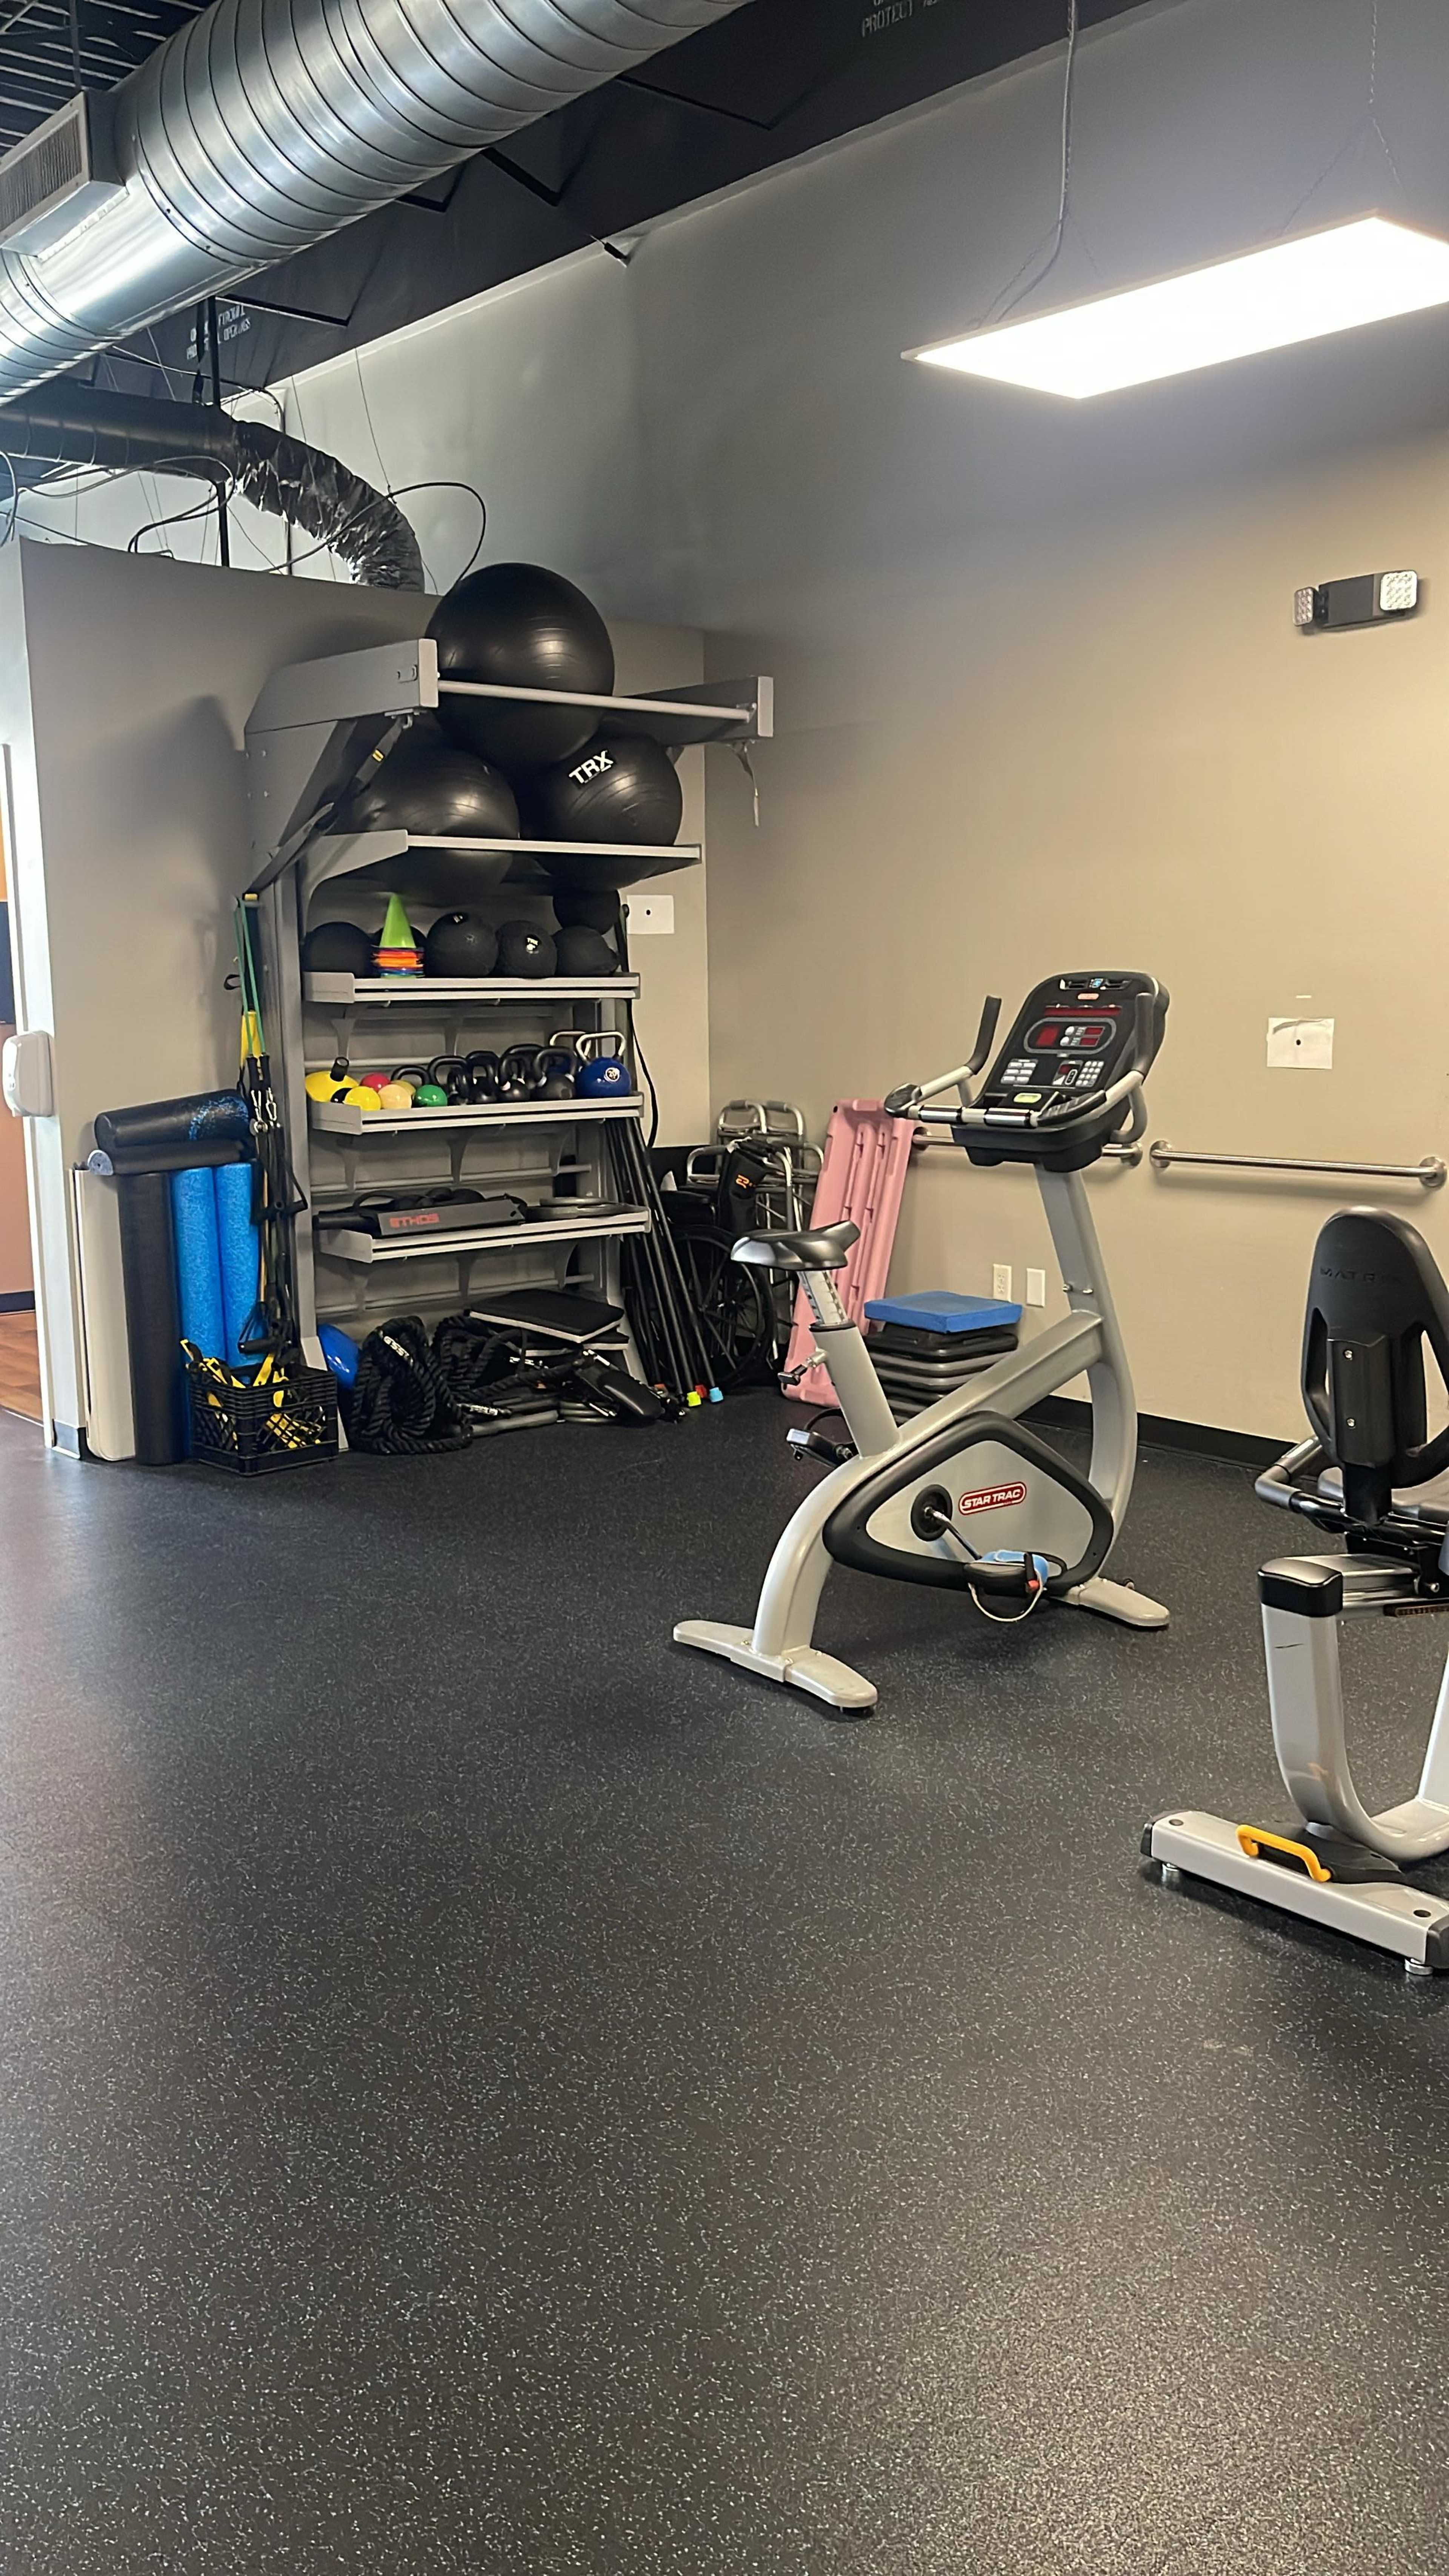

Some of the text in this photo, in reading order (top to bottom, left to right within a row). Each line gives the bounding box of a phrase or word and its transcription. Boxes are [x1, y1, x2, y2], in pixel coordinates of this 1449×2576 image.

[569, 750, 614, 783] TRX
[962, 1489, 1020, 1509] STAR TRAC
